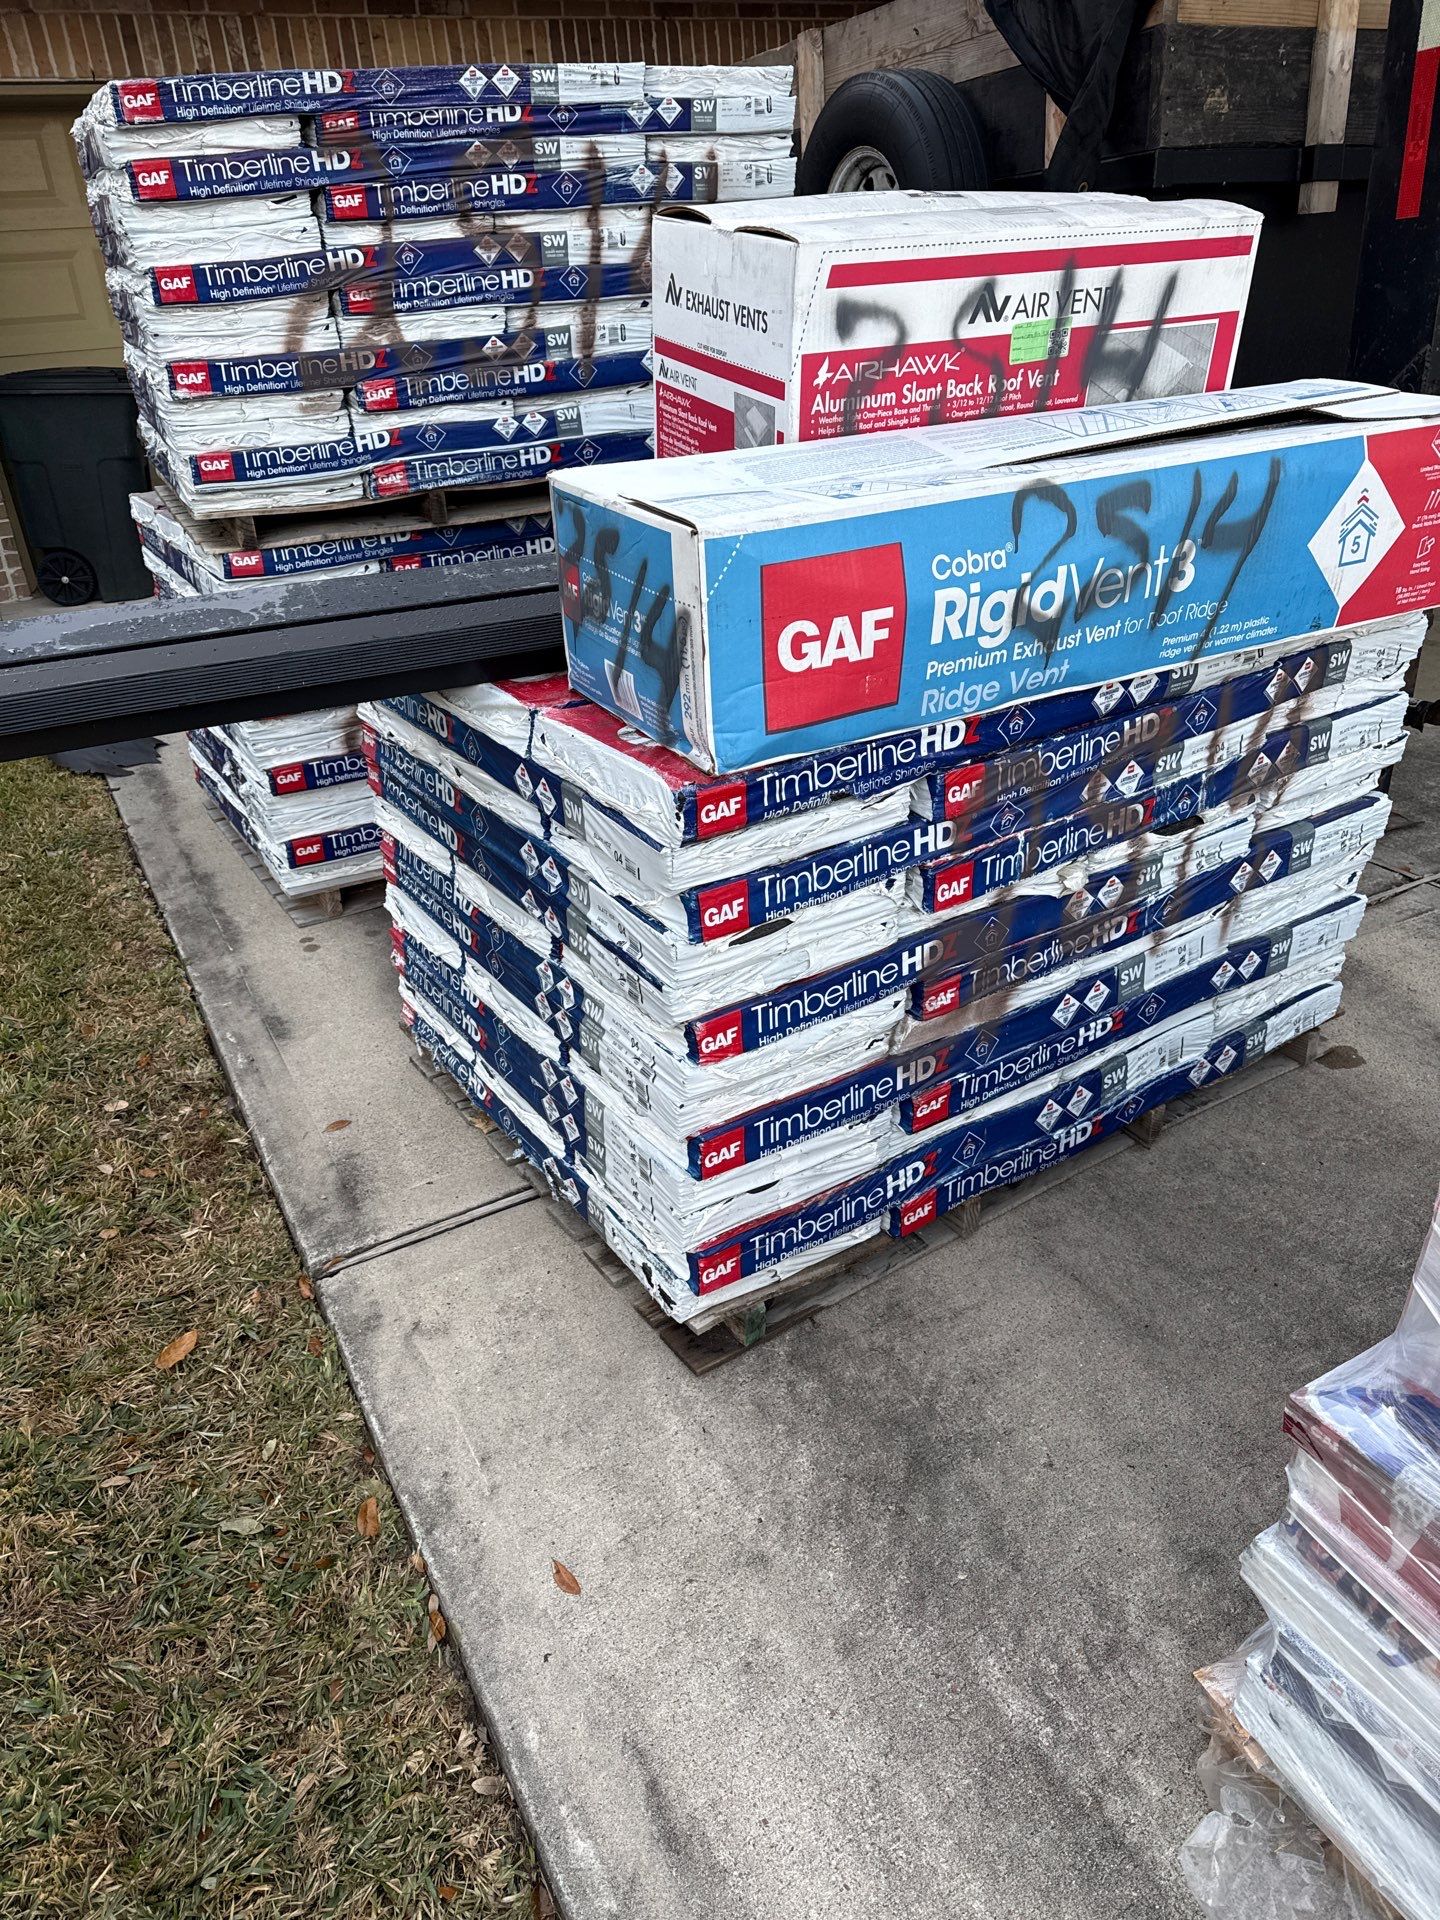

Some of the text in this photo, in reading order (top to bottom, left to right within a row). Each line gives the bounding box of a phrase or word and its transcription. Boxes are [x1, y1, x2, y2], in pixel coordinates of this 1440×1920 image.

[532, 69, 555, 83] SW
[124, 93, 156, 109] GAF
[693, 100, 714, 112] SW
[176, 106, 198, 118] High
[373, 130, 391, 141] High
[534, 142, 557, 154] SW
[138, 170, 170, 188] GAF
[190, 185, 212, 198] High
[295, 175, 330, 187] Shingles
[334, 194, 362, 208] GAF
[543, 235, 565, 246] SW
[161, 277, 190, 290] GAF
[210, 290, 231, 300] High
[393, 301, 412, 310] High
[686, 289, 768, 333] EXHAUST VENTS
[1012, 292, 1050, 320] AIR
[547, 333, 569, 345] SW
[832, 352, 961, 384] AIRHAWK
[177, 373, 206, 385] GAF
[670, 369, 697, 391] AIR VENT
[224, 384, 244, 394] High
[366, 387, 394, 401] GAF
[902, 381, 942, 404] Slant
[946, 374, 983, 399] Back
[409, 397, 427, 406] High
[952, 397, 967, 408] 3/12
[556, 408, 578, 421] SW
[818, 426, 835, 435] Helps
[859, 420, 873, 430] Roof
[887, 417, 909, 427] Shingle
[201, 460, 230, 472] GAF
[247, 470, 266, 478] High
[341, 453, 372, 466] Shingles
[377, 471, 404, 486] GAF
[419, 480, 436, 489] High
[232, 556, 259, 567] GAF
[275, 563, 294, 572] High
[777, 606, 894, 673] GAF
[926, 650, 1007, 680] Premium
[1086, 622, 1121, 644] Vent
[1124, 617, 1144, 635] for
[1185, 600, 1228, 620] Ridge
[1162, 632, 1198, 647] Premium
[1244, 616, 1270, 629] plastic
[1159, 626, 1278, 659] ridge warmer climates
[1329, 649, 1350, 668] SW
[920, 679, 998, 717] Ridge
[1010, 659, 1070, 695] Vent
[1310, 731, 1330, 752] SW
[1156, 752, 1182, 773] SW
[276, 772, 301, 784] GAF
[316, 779, 332, 787] High
[948, 780, 982, 803] GAF
[563, 797, 582, 824] SW
[701, 797, 742, 824] GAF
[296, 844, 321, 856] GAF
[335, 849, 351, 857] High
[1292, 839, 1313, 858] SW
[569, 876, 590, 906] SW
[937, 877, 970, 902] GAF
[704, 898, 744, 927] GAF
[766, 907, 791, 921] High
[1271, 938, 1292, 957] SW
[1120, 962, 1144, 985] SW
[925, 989, 956, 1012] GAF
[582, 999, 602, 1022] SW
[581, 1031, 599, 1054] SW
[700, 1027, 738, 1054] GAF
[759, 1032, 784, 1047] High
[1246, 1027, 1267, 1049] SW
[1103, 1065, 1128, 1089] SW
[585, 1098, 602, 1121] SW
[916, 1095, 948, 1118] GAF
[960, 1097, 980, 1111] High
[587, 1135, 604, 1159] SW
[704, 1142, 741, 1168] GAF
[903, 1202, 932, 1227] GAF
[702, 1258, 737, 1284] GAF
[755, 1258, 778, 1272] High
